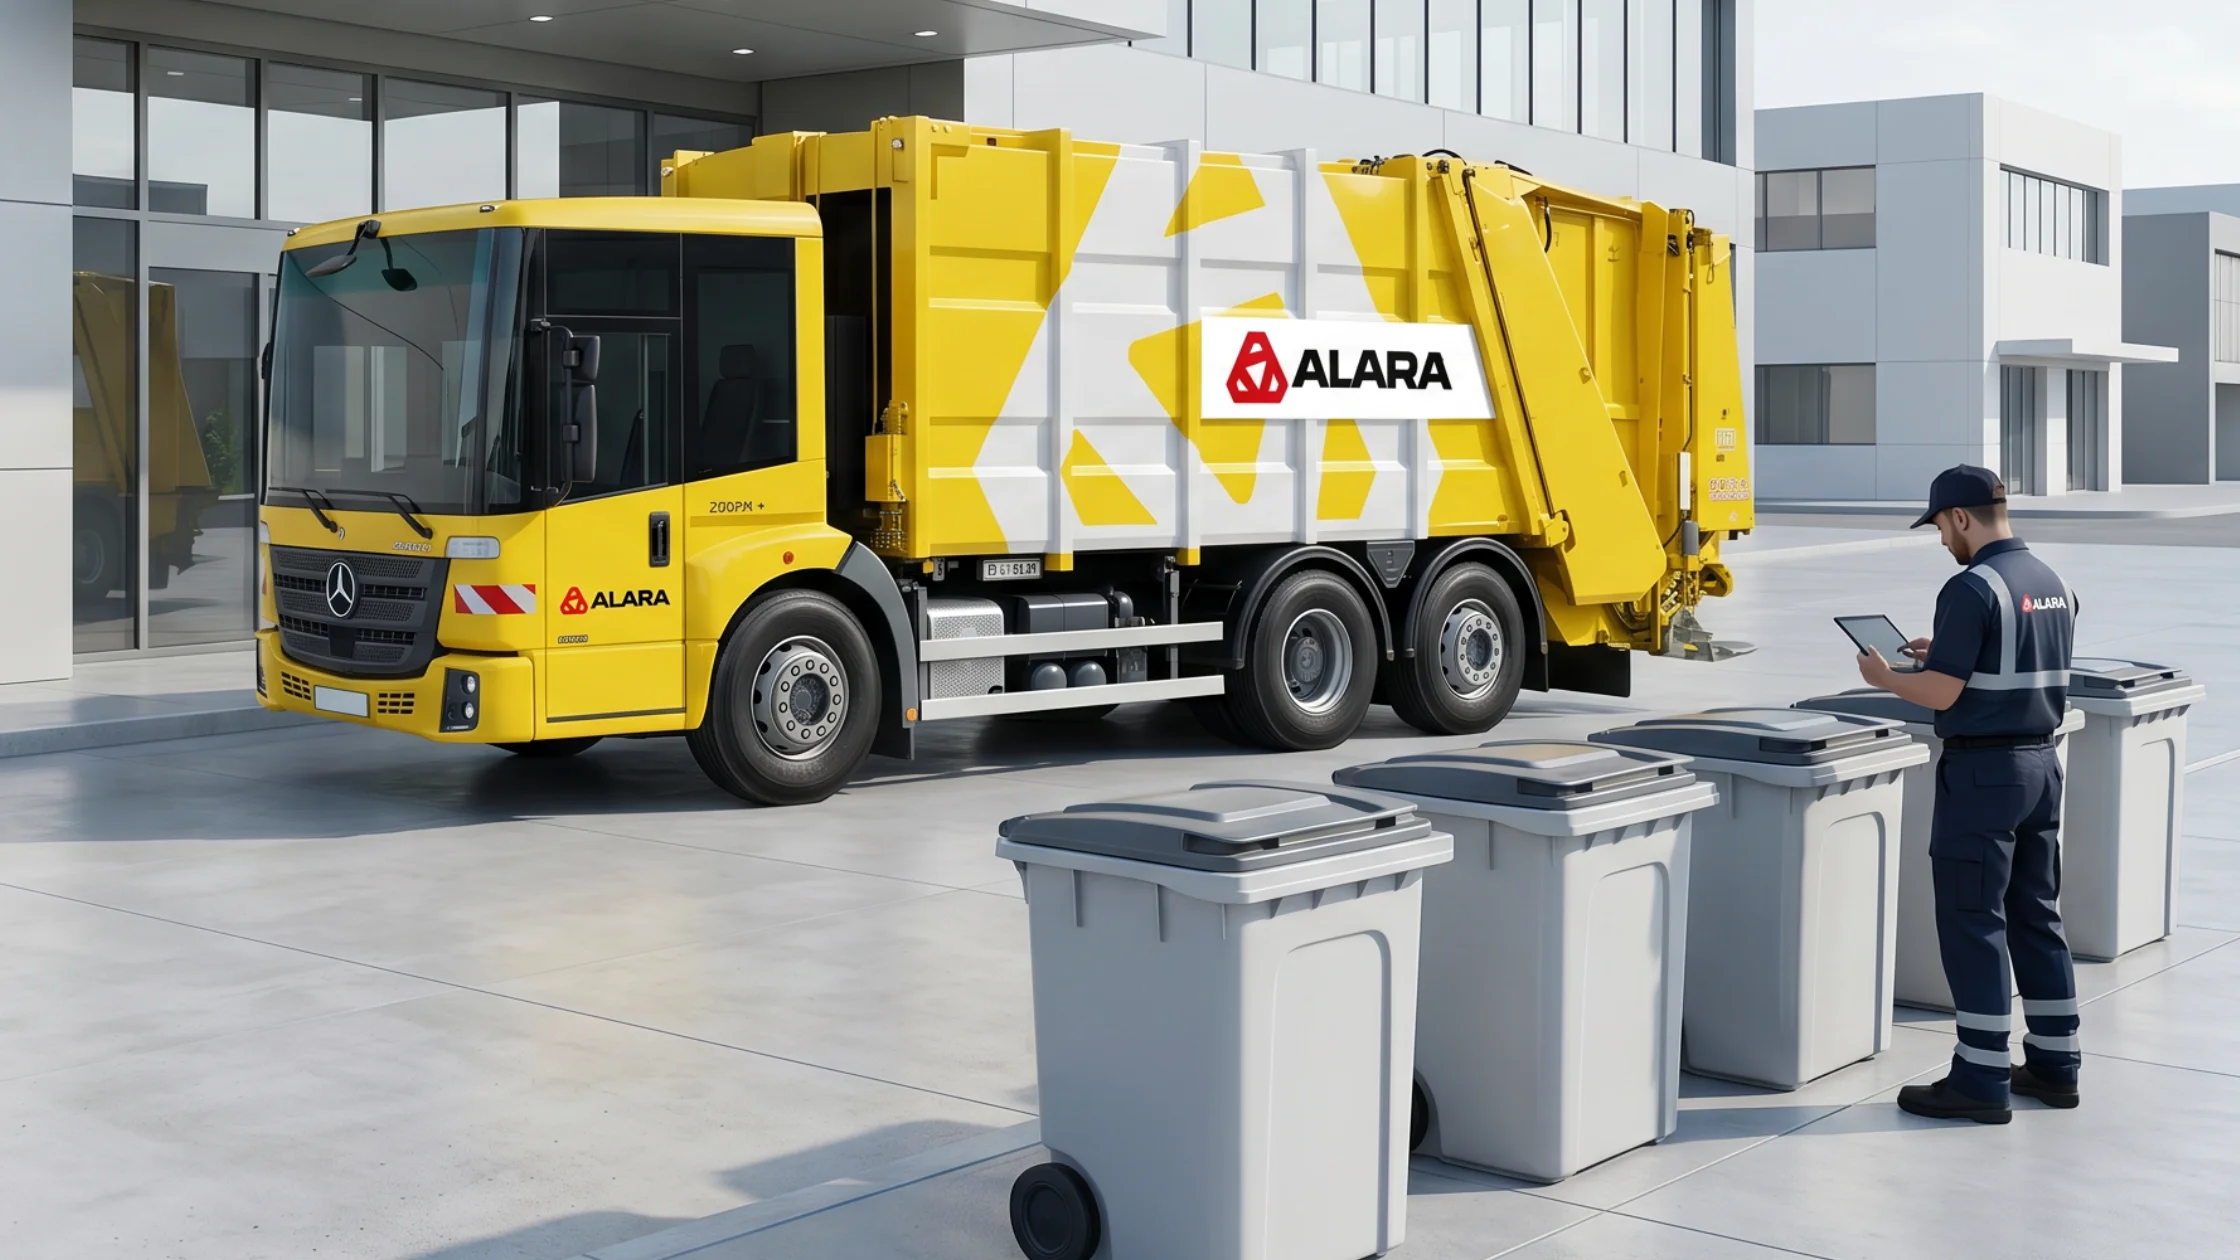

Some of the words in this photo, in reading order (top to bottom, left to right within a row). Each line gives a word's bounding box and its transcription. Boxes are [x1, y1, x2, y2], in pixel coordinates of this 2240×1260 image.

[1291, 348, 1453, 391] ALARA
[590, 589, 671, 609] ALARA
[2032, 596, 2068, 610] ALARA
